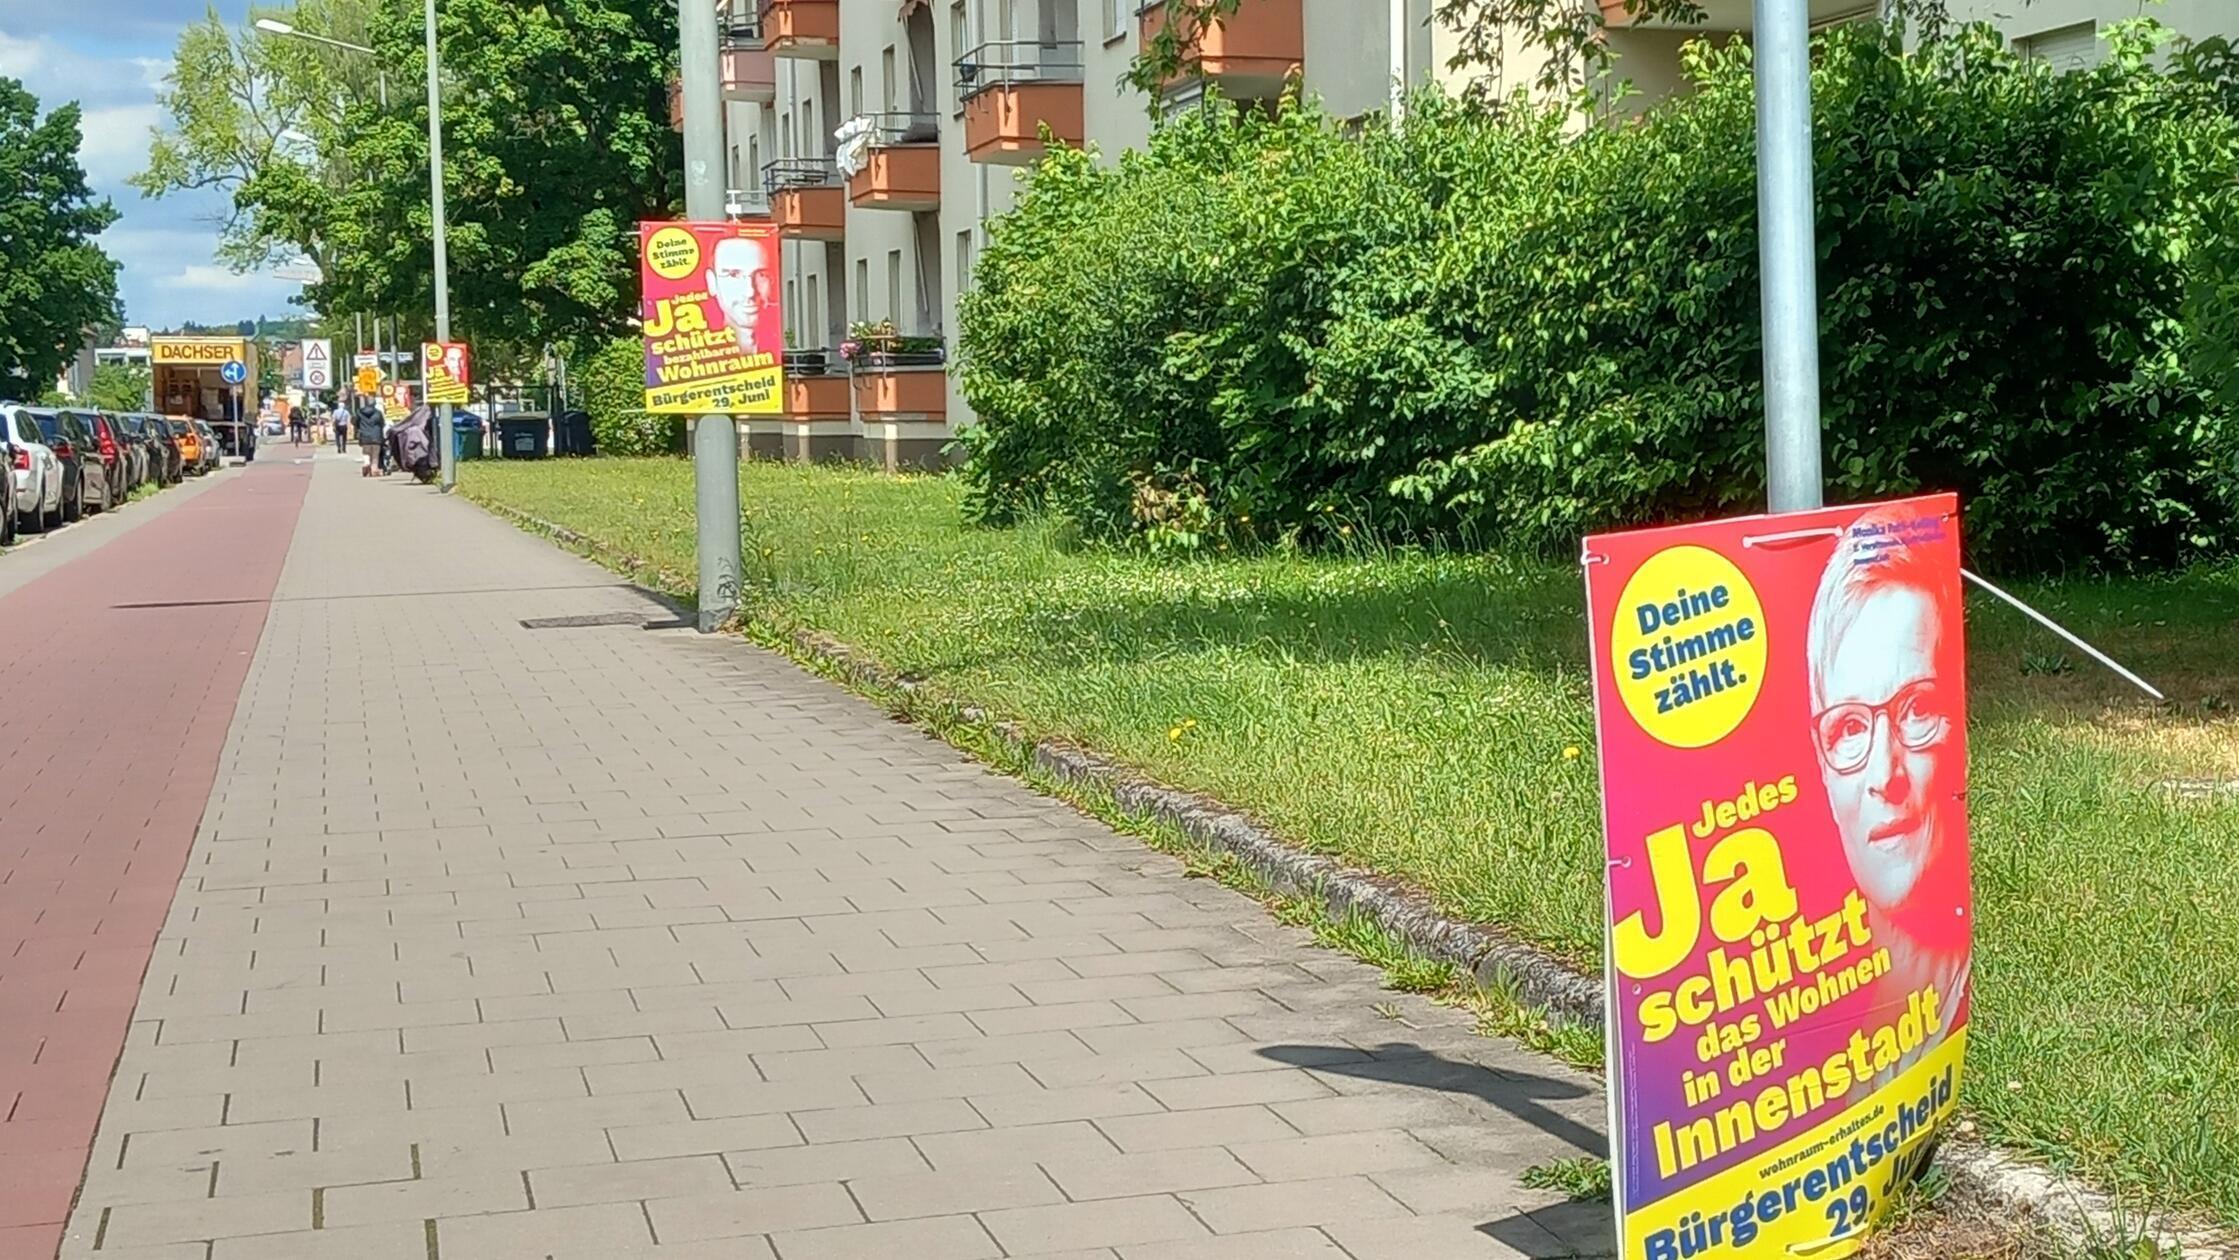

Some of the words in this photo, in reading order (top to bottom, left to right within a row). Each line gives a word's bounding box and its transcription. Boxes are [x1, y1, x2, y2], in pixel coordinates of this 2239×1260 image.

[644, 299, 708, 337] Ja
[651, 326, 737, 355] schützt
[161, 344, 235, 360] DACHSER
[656, 352, 774, 383] Wohnraum
[652, 375, 776, 407] Bürgerentscheid
[712, 396, 734, 409] 29.
[738, 389, 770, 405] Juni
[1636, 583, 1730, 636] Deine
[1628, 614, 1756, 680] Stimme
[1653, 657, 1748, 715] zählt.
[1691, 774, 1799, 839] Jedes
[1613, 822, 1799, 979] Ja
[1638, 888, 1873, 1043] schützt
[1696, 1013, 1762, 1063] das
[1764, 946, 1892, 1030] Wohnen
[1652, 983, 1942, 1181] Innenstadt
[1682, 1069, 1721, 1108] in
[1728, 1037, 1787, 1087] der
[1643, 1062, 1953, 1260] Bürgerentscheid
